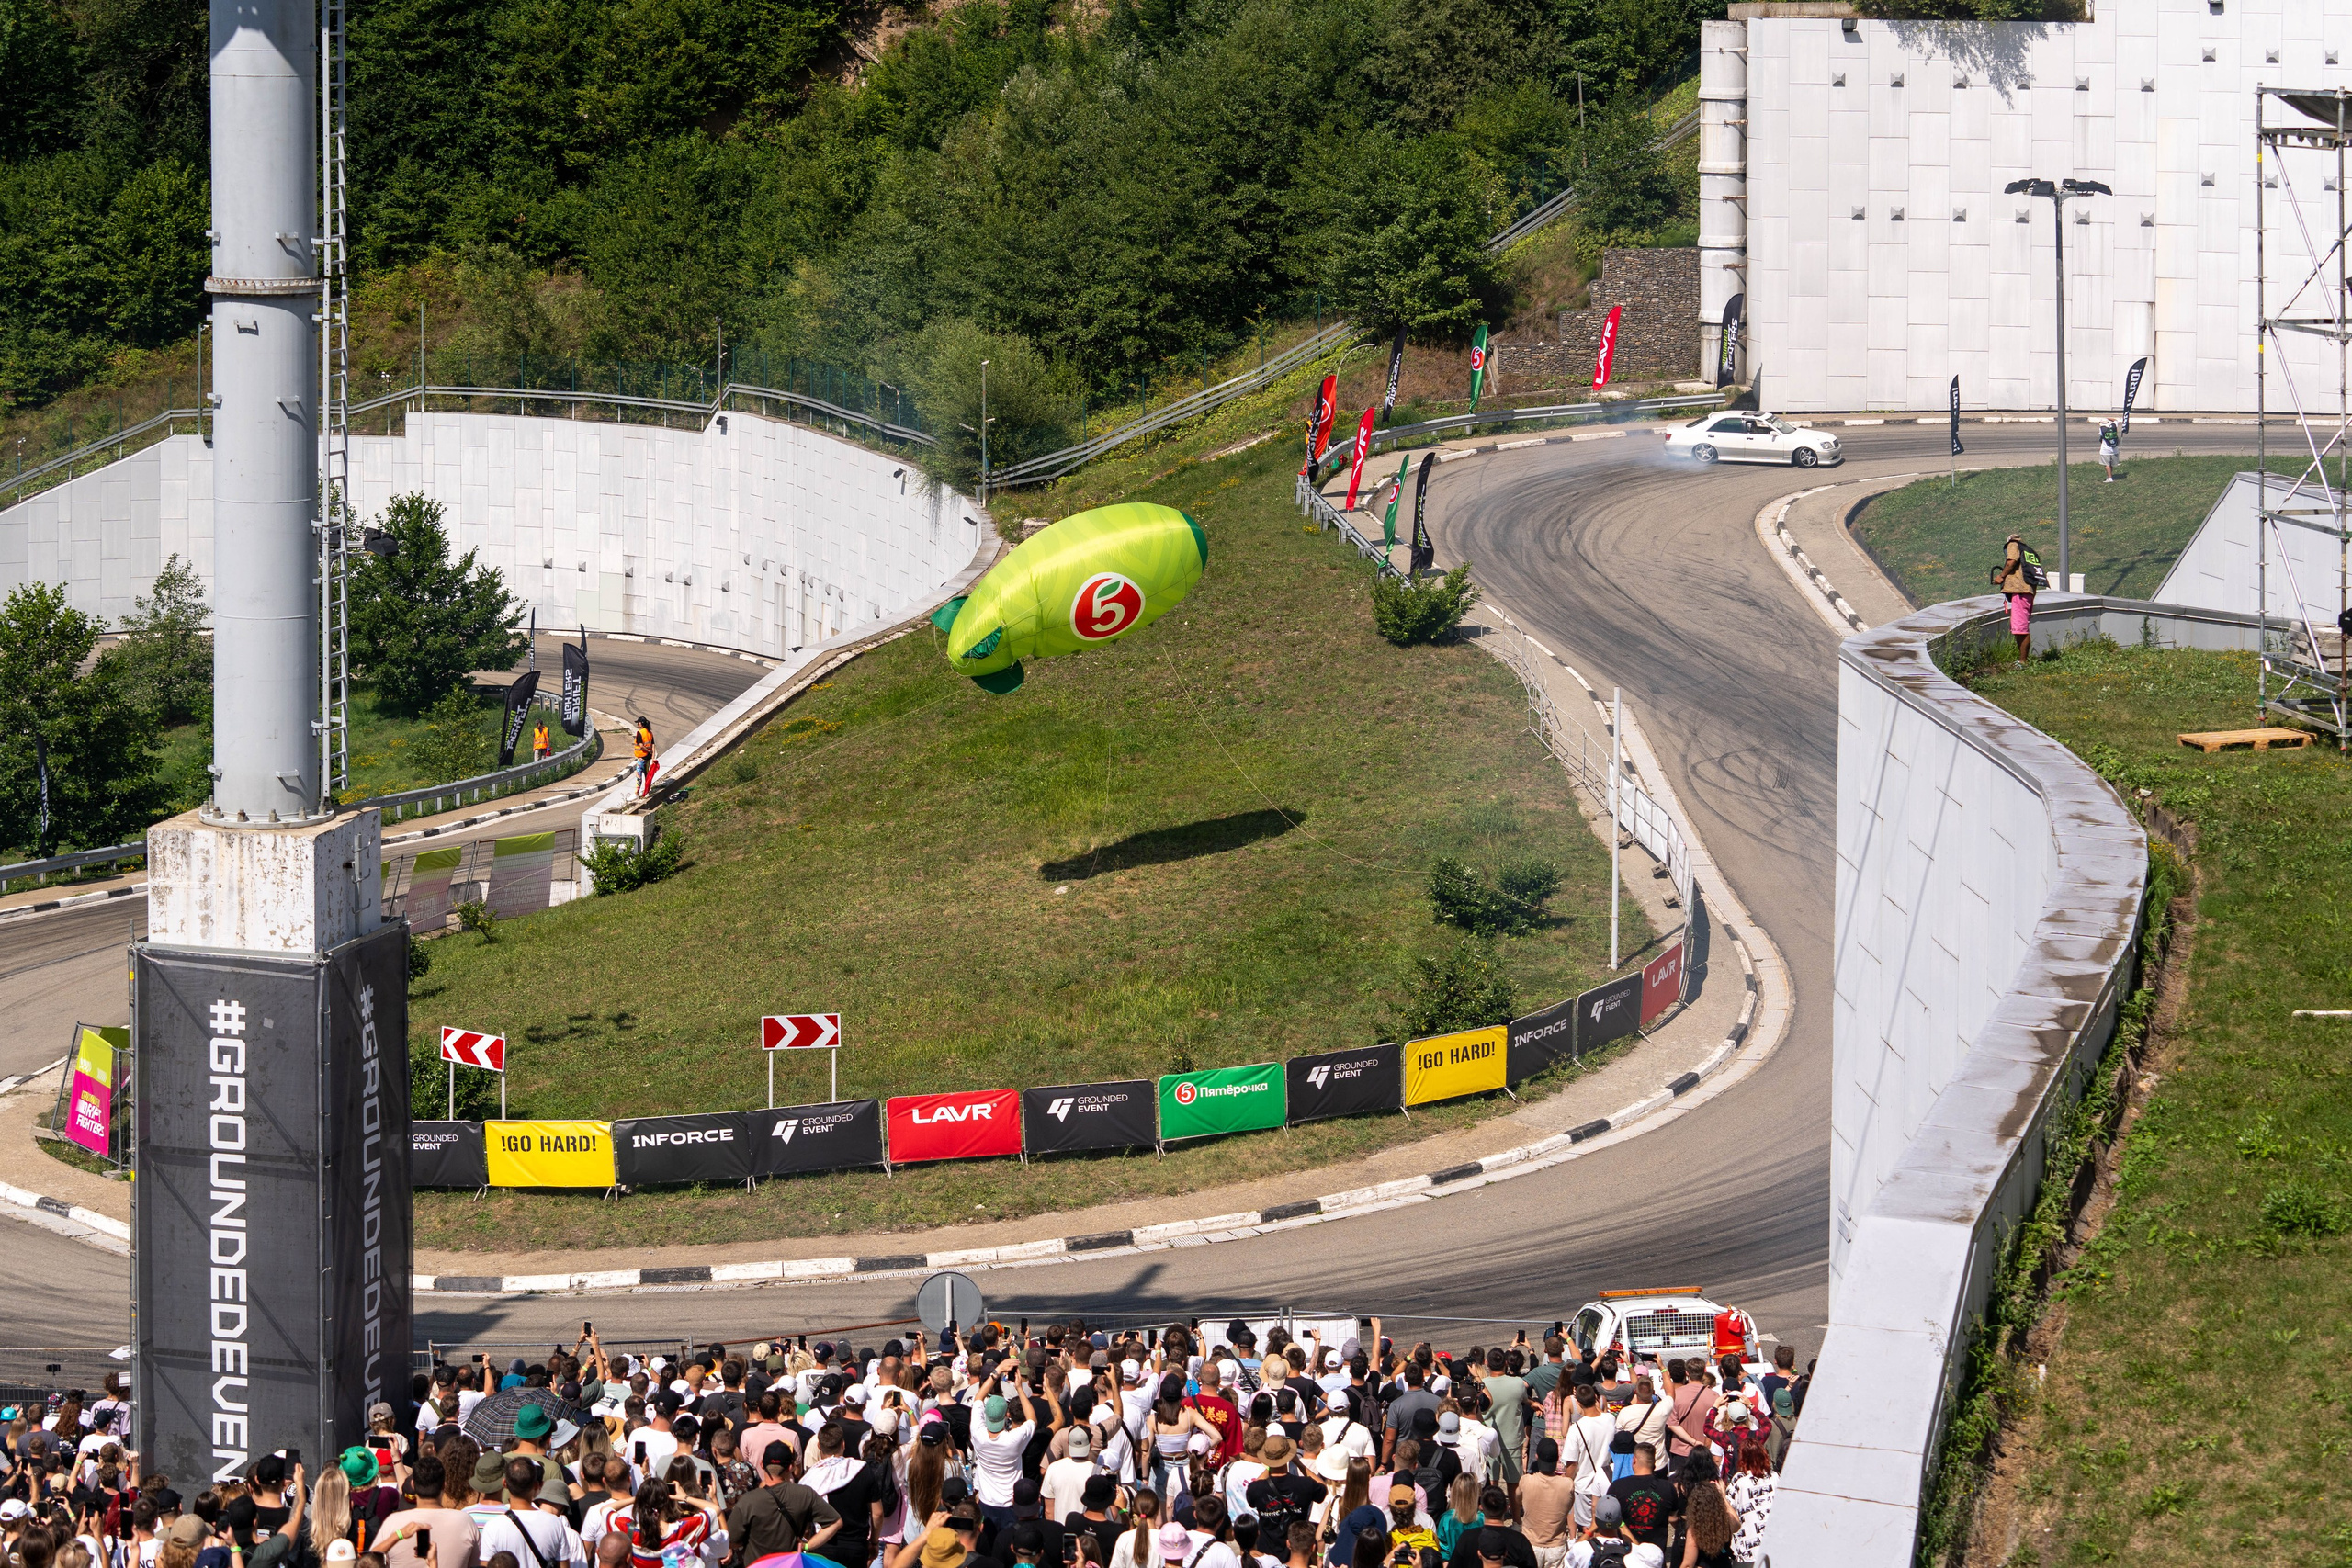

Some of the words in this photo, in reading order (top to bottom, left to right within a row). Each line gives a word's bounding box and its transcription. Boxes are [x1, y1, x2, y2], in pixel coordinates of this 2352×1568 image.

[1595, 321, 1613, 385] LAVR
[1652, 959, 1676, 987] LAVR
[1605, 988, 1631, 1005] GROUNDED
[1605, 999, 1621, 1012] EVENT
[1514, 1018, 1567, 1048] INFORCE
[1418, 1051, 1443, 1071] !GO
[1451, 1041, 1495, 1065] HARD!
[1333, 1059, 1378, 1072] GROUNDED
[1333, 1069, 1362, 1079] EVENT
[1199, 1083, 1269, 1098] Пятёрочка
[1077, 1094, 1128, 1105] GROUNDED
[1078, 1103, 1109, 1113] EVENT
[801, 1113, 854, 1126] GROUNDED
[911, 1103, 992, 1124] LAVR
[76, 1113, 105, 1137] FIGHTERS
[802, 1123, 834, 1134] EVENT
[413, 1134, 458, 1143] GROUNDED
[413, 1142, 442, 1151] EVENT
[501, 1135, 532, 1153] !GO
[539, 1135, 597, 1153] HARD!
[632, 1128, 734, 1148] INFORCE
[359, 984, 382, 1440] #GROUNDEDEVE
[209, 999, 248, 1483] #GROUNDEDEVEN
